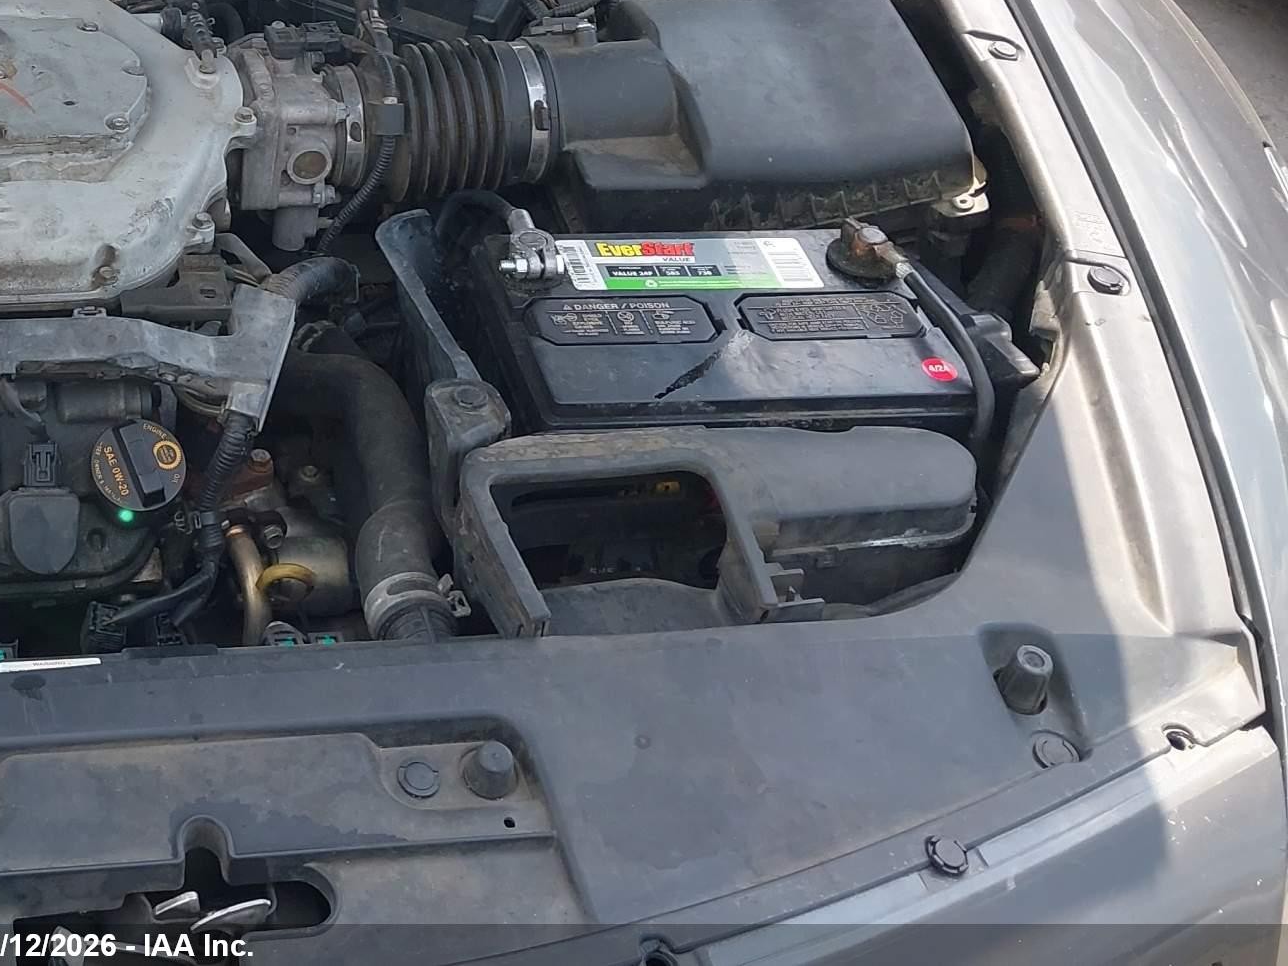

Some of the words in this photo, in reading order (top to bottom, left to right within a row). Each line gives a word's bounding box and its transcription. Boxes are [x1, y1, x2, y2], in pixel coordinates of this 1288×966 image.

[595, 242, 694, 256] EverStart
[143, 423, 167, 439] ENGINE
[104, 446, 117, 467] SAE
[112, 467, 129, 496] 0W-20
[172, 473, 181, 484] OIL
